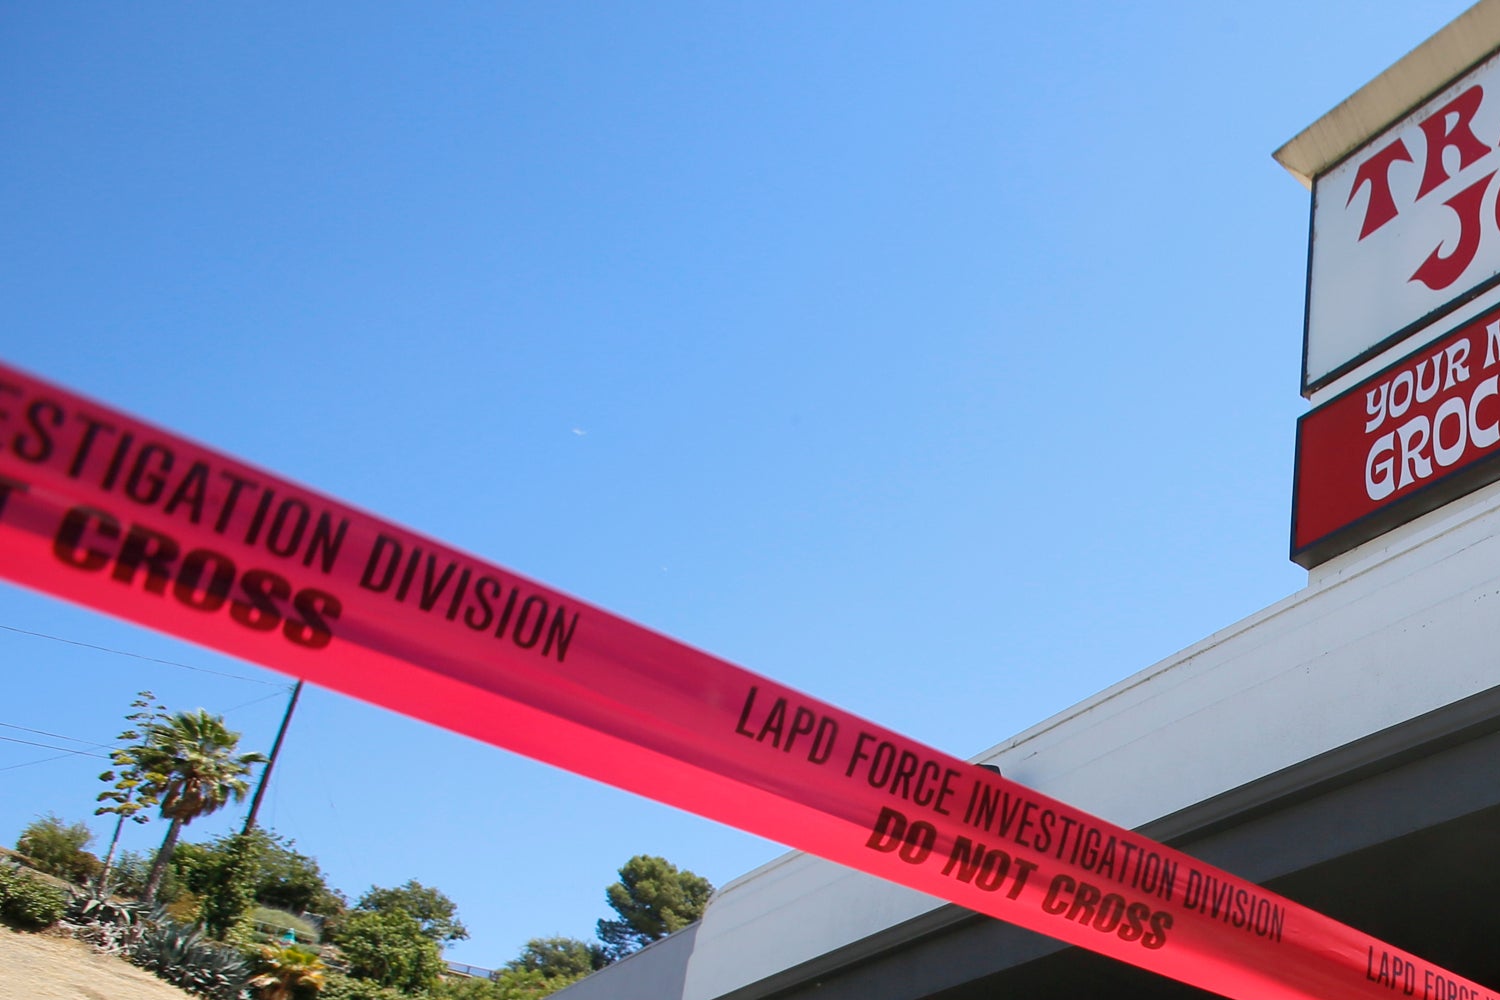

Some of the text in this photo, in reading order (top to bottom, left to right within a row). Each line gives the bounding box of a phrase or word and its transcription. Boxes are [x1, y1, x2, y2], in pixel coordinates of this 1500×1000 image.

[1365, 337, 1470, 433] YOUR
[52, 504, 343, 650] CROSS
[359, 533, 580, 662] DIVISION
[735, 686, 1286, 944] LAPD FORCE INVESTIGATION DIVISION
[864, 806, 1174, 951] DO NOT CROSS
[1365, 945, 1416, 997] LAPD
